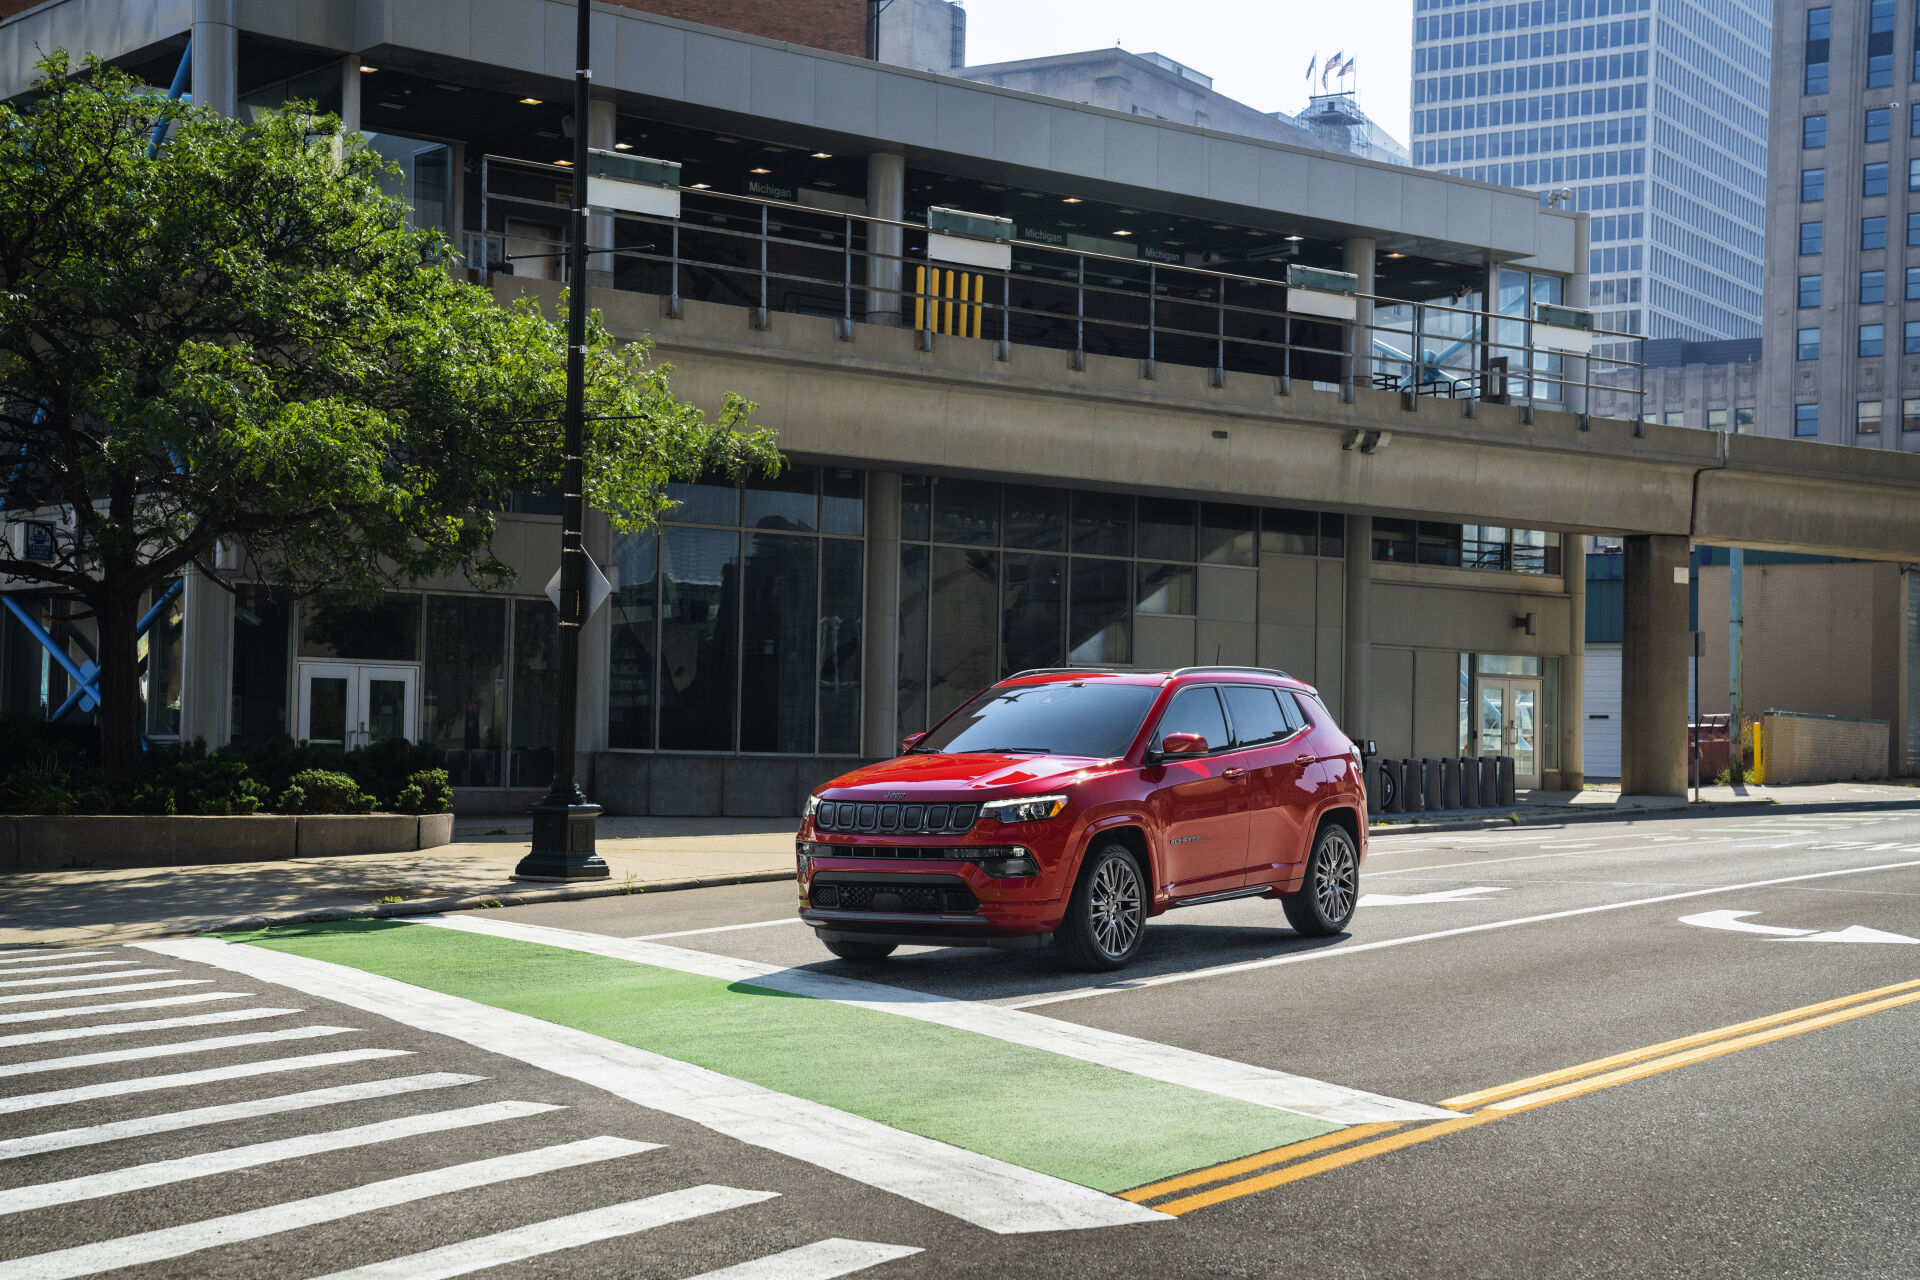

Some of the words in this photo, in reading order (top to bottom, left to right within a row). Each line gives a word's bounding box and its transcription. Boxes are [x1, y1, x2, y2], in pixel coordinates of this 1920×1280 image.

[749, 181, 792, 198] Michigan
[1024, 227, 1062, 243] Michigan
[1145, 247, 1180, 262] Michigan
[883, 791, 906, 799] Jeep
